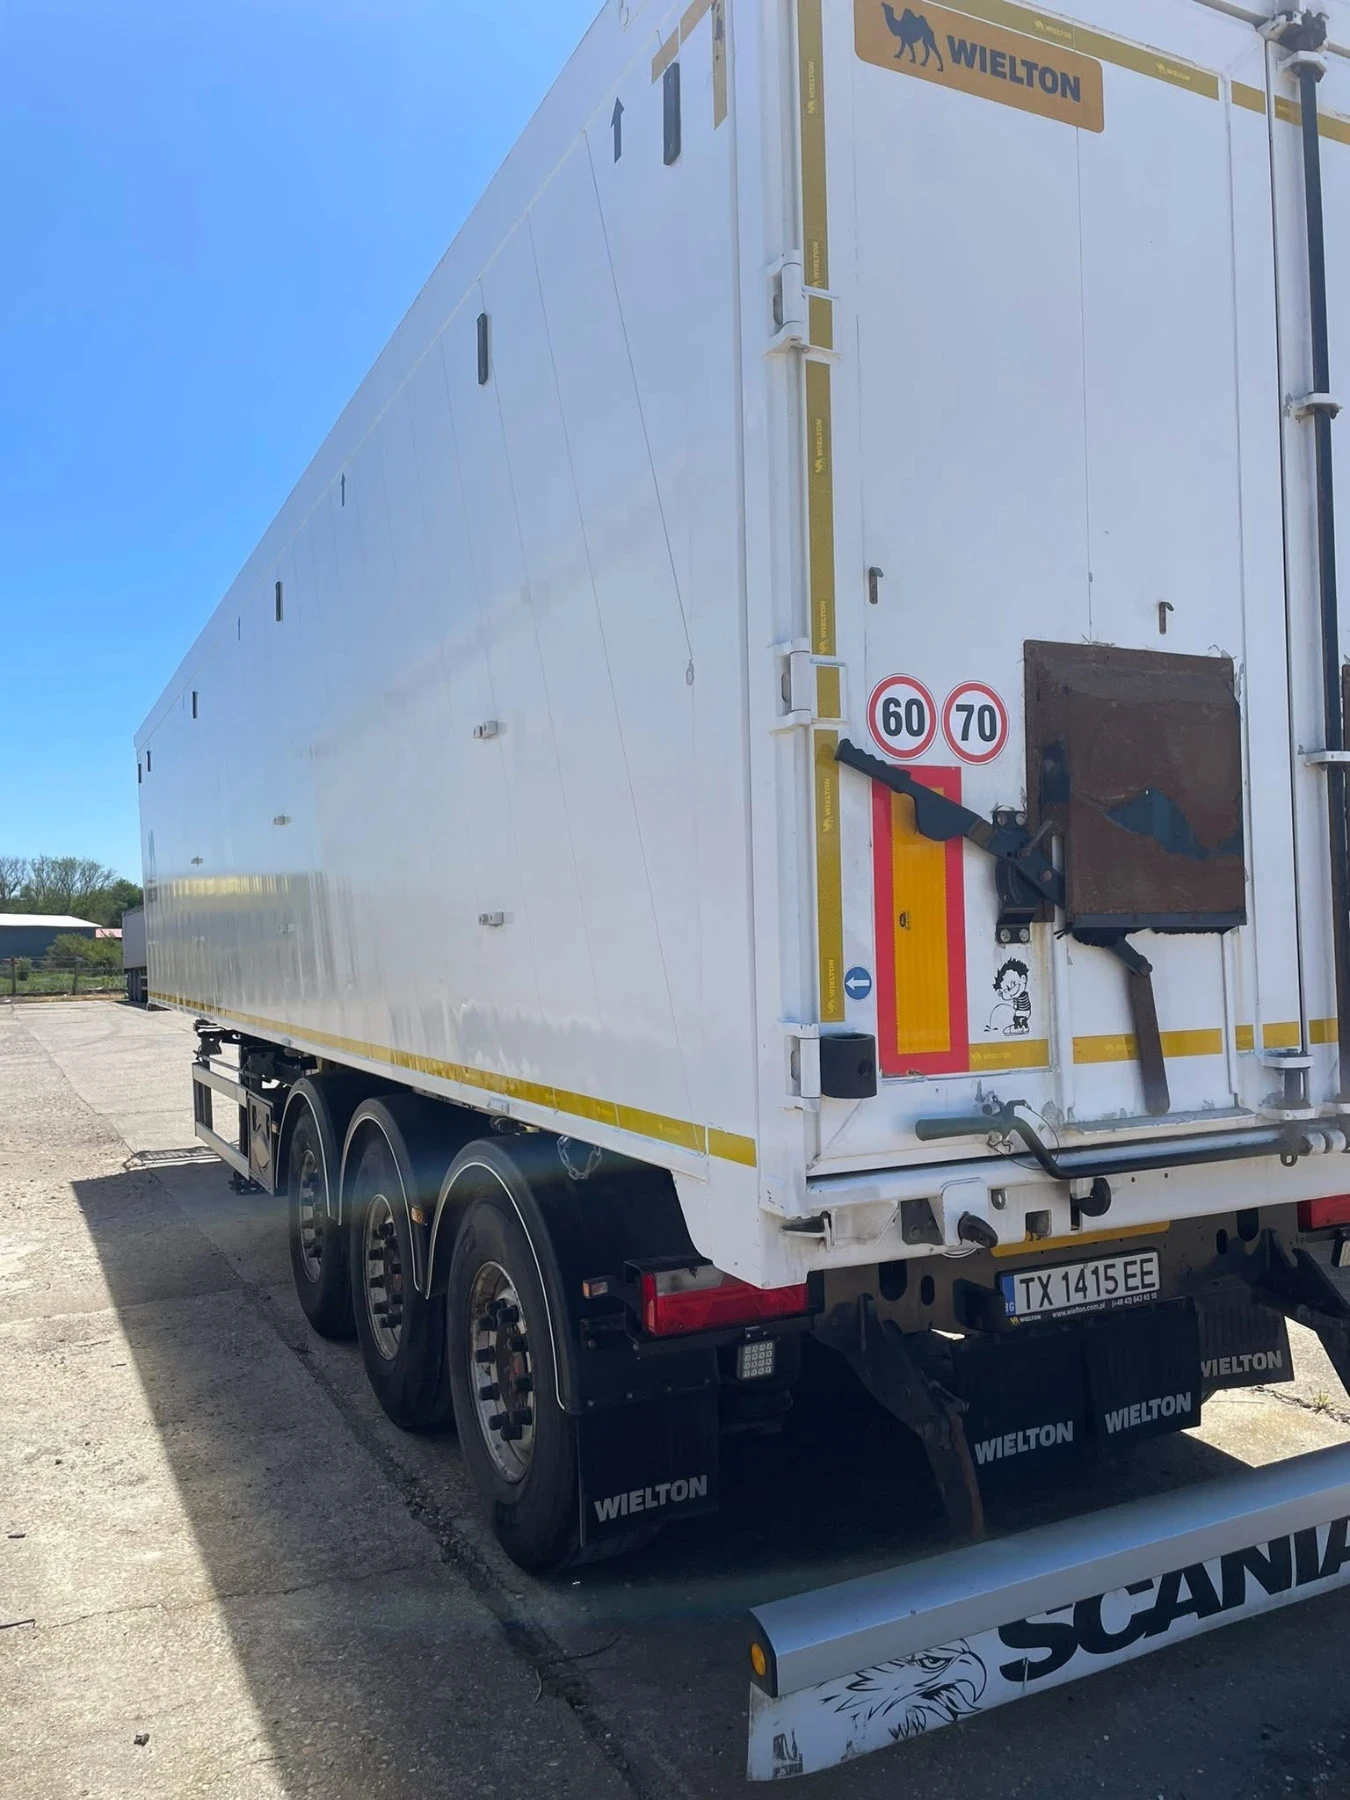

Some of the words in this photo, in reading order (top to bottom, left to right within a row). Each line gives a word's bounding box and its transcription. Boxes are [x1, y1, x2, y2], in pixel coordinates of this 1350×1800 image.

[946, 34, 1081, 103] WIELTON
[882, 697, 925, 737] 60
[955, 704, 997, 742] 70
[1019, 1274, 1053, 1310] TX
[1062, 1264, 1119, 1303] 1415
[1123, 1258, 1156, 1293] EE
[1104, 1392, 1192, 1434] WIELTON
[974, 1421, 1074, 1465] WIELTON
[594, 1474, 707, 1523] WIELTON
